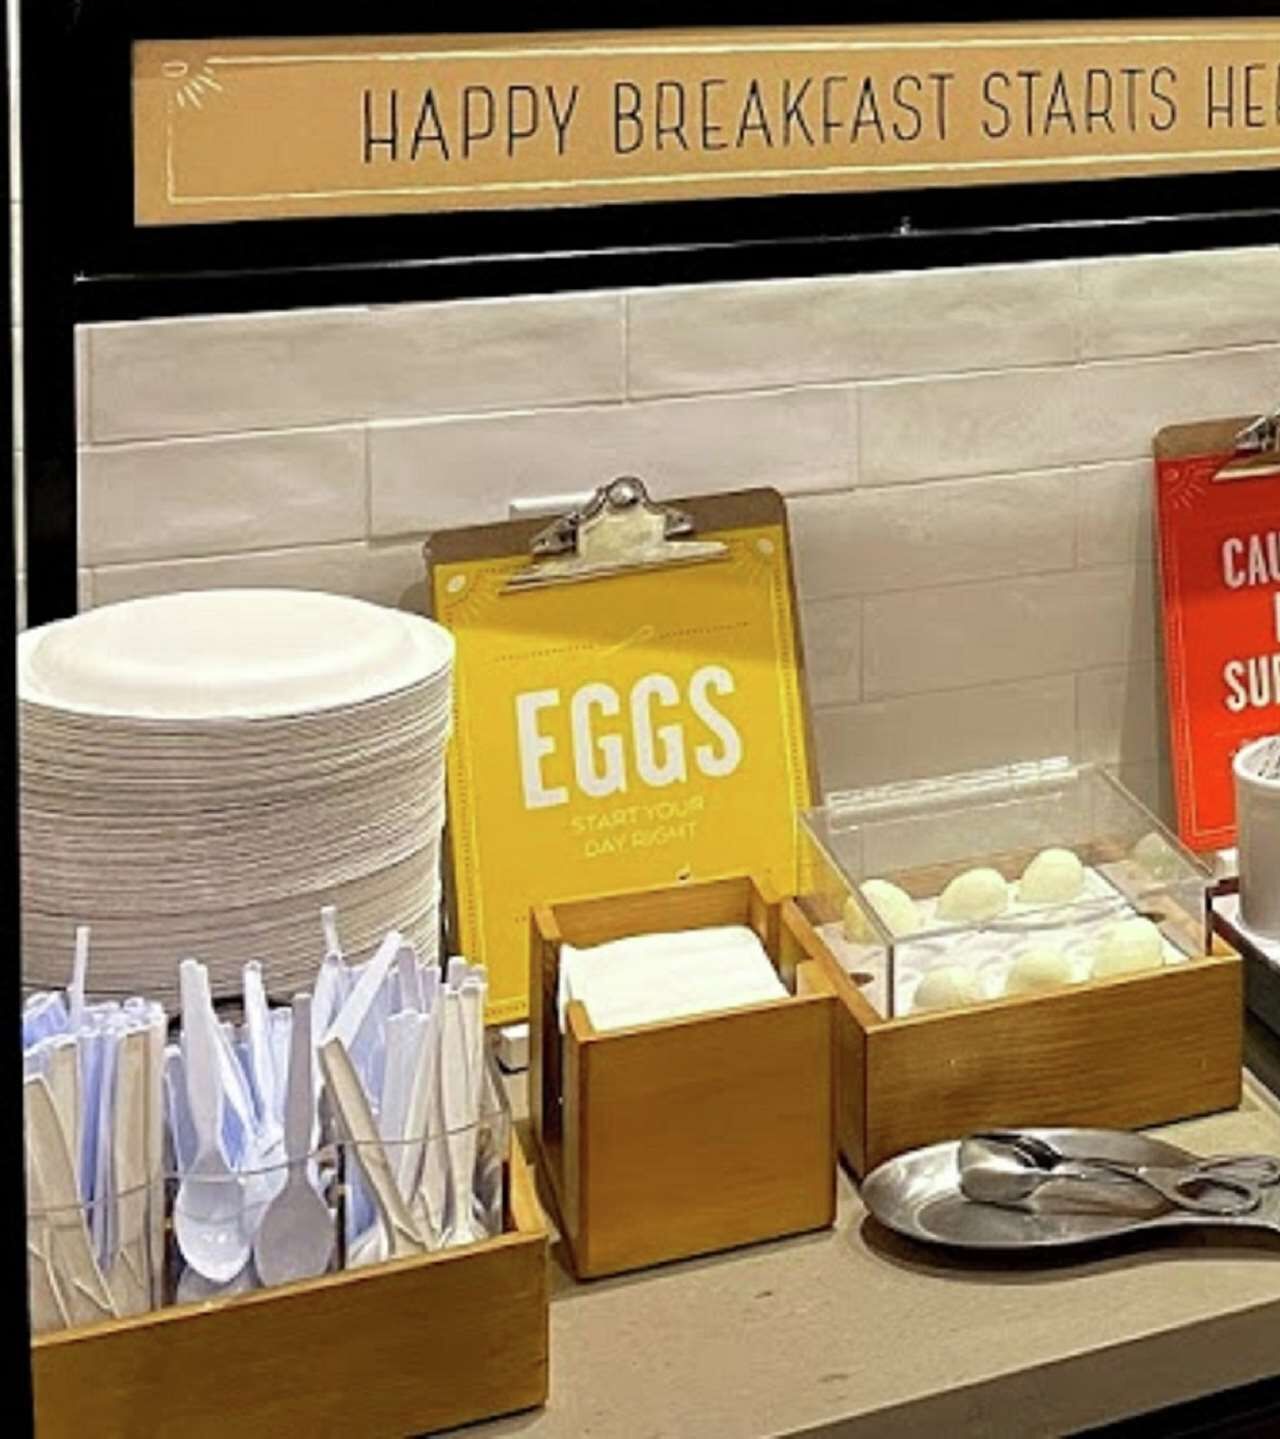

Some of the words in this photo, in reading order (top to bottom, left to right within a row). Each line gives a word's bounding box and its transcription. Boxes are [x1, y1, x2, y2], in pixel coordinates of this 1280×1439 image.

[361, 85, 580, 164] HAPPY
[613, 71, 955, 155] BREAKFAST
[980, 66, 1178, 140] STARTS
[514, 664, 743, 812] EGGS
[570, 805, 638, 833] START
[646, 794, 705, 821] YOUR
[584, 833, 628, 858] DAY
[630, 821, 697, 849] RIGHT
